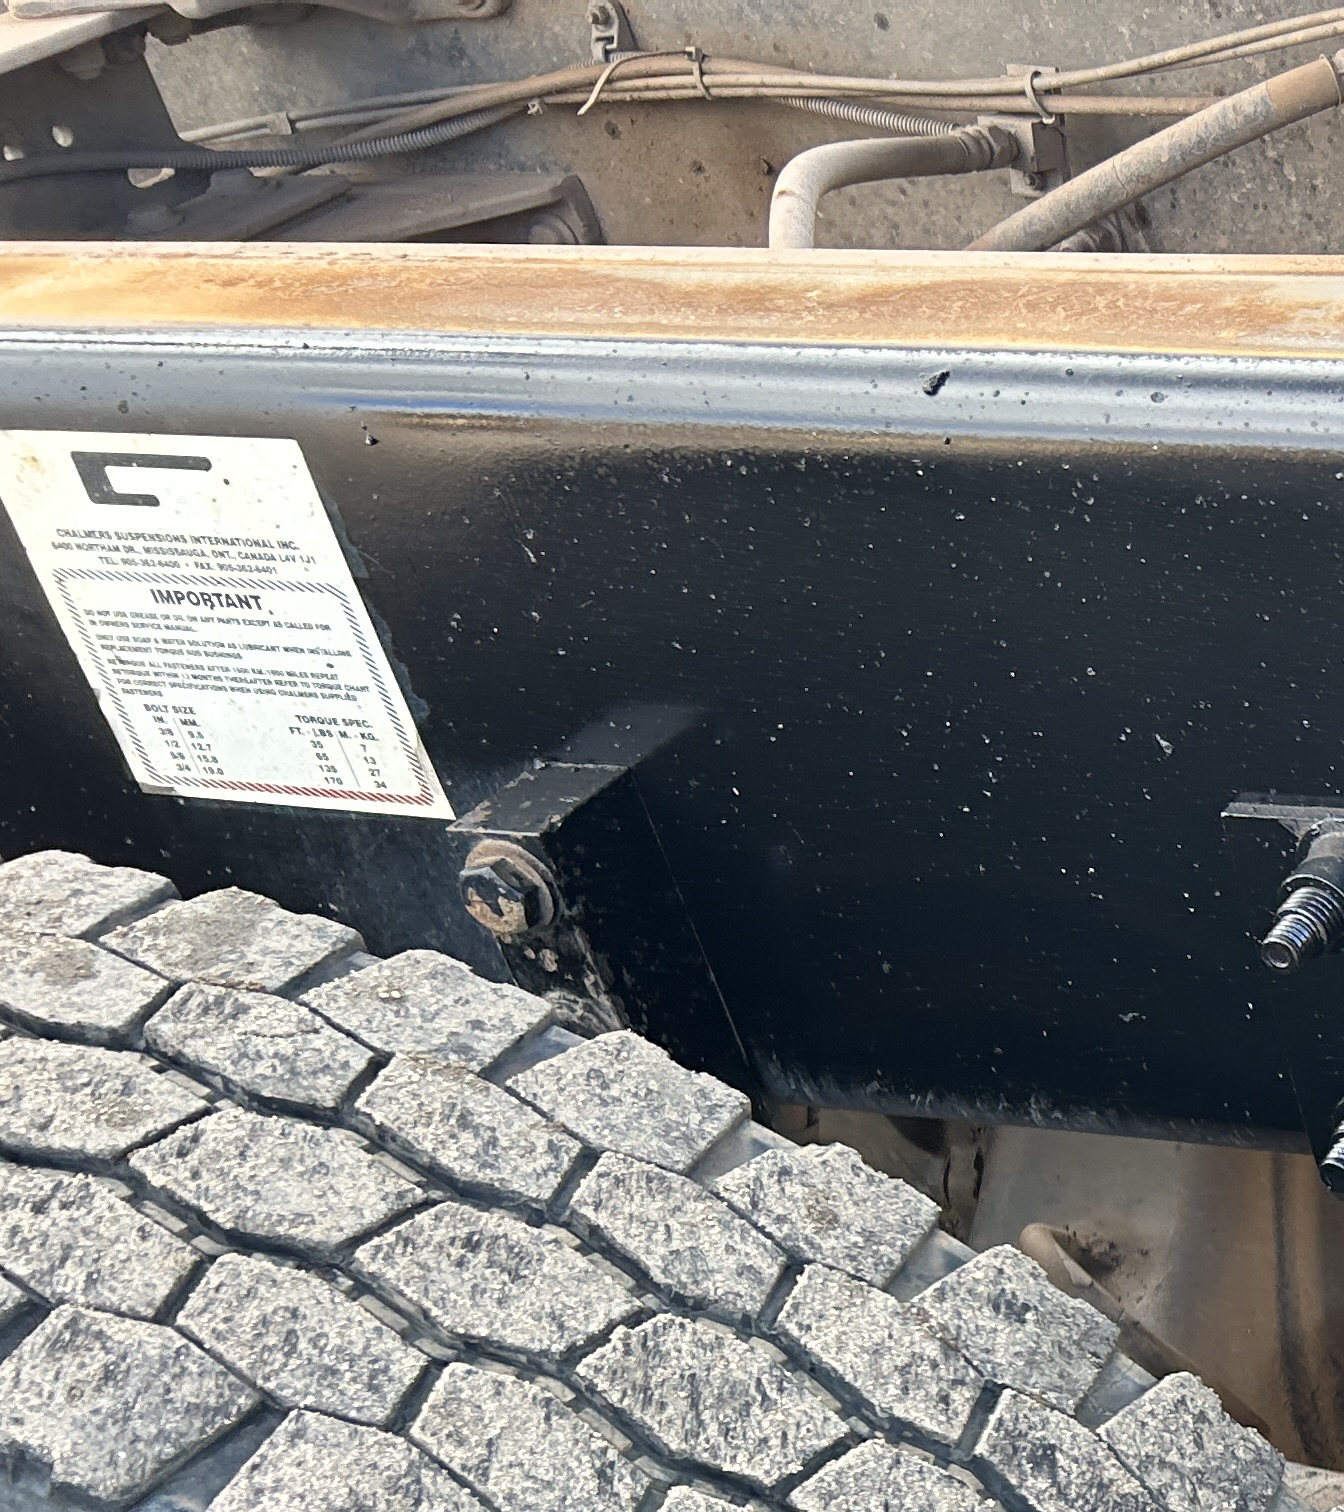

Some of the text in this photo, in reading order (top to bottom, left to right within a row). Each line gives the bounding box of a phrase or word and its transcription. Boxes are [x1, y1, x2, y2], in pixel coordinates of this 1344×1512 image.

[55, 528, 300, 550] CHALMERS SUSPENSIONS INTERNATIONAL INC.
[236, 551, 277, 561] CANADA
[149, 588, 265, 610] IMPORTANT
[142, 703, 196, 715] BOLT SIZE
[294, 714, 373, 728] TORQUE SPEC.
[163, 739, 181, 748] 1/2
[190, 742, 213, 751] 12.7
[309, 739, 324, 749] 35
[196, 754, 219, 763] 15.8
[314, 752, 330, 761] 65
[362, 755, 377, 764] 13
[174, 762, 192, 772] 3/4
[367, 767, 382, 777] 27
[323, 776, 344, 785] 170
[372, 780, 388, 789] 34
